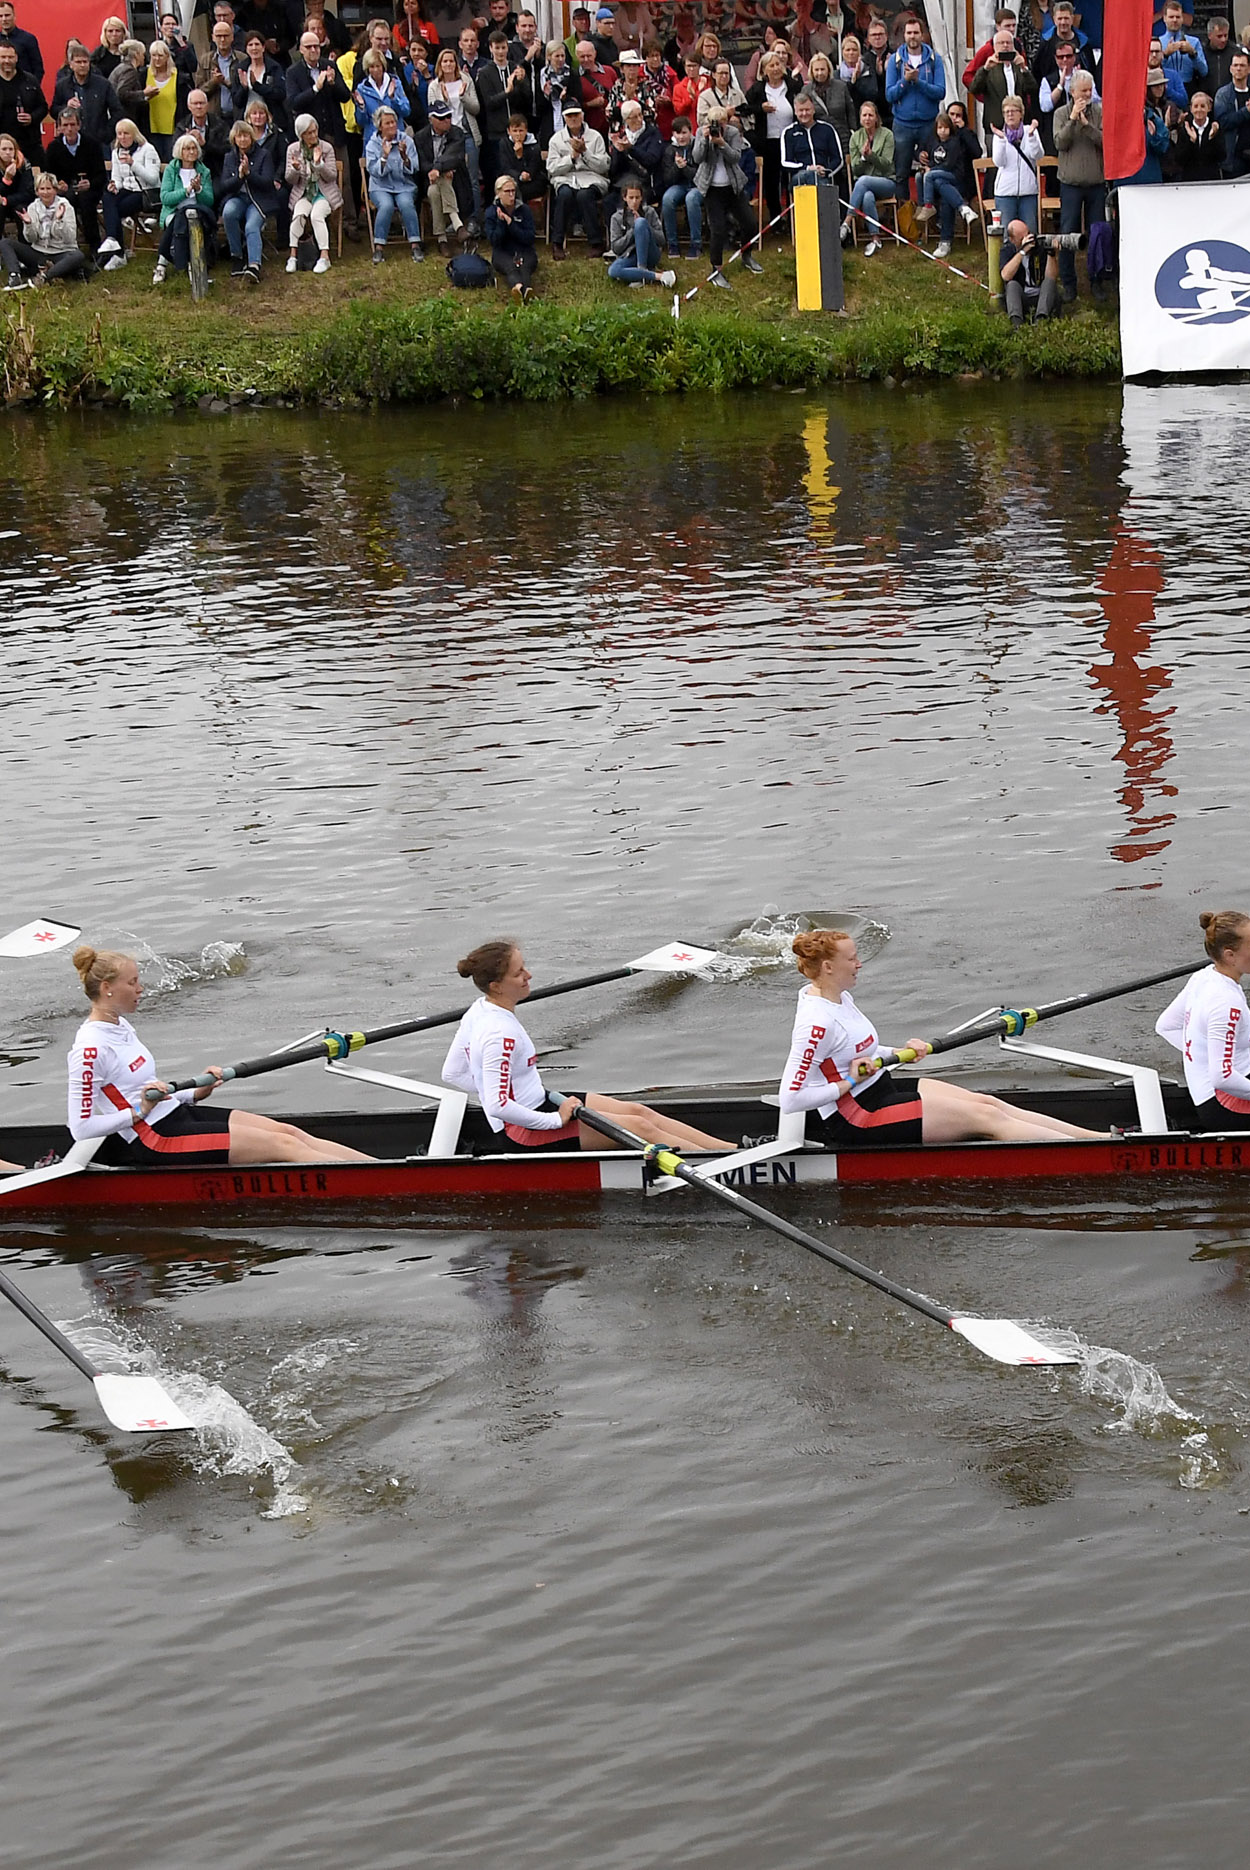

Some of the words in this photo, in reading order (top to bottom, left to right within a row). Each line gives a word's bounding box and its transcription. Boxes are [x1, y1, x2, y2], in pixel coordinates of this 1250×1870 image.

[788, 1025, 826, 1091] Bremen
[1222, 1007, 1242, 1078] Bremen
[80, 1047, 98, 1119] Bremen
